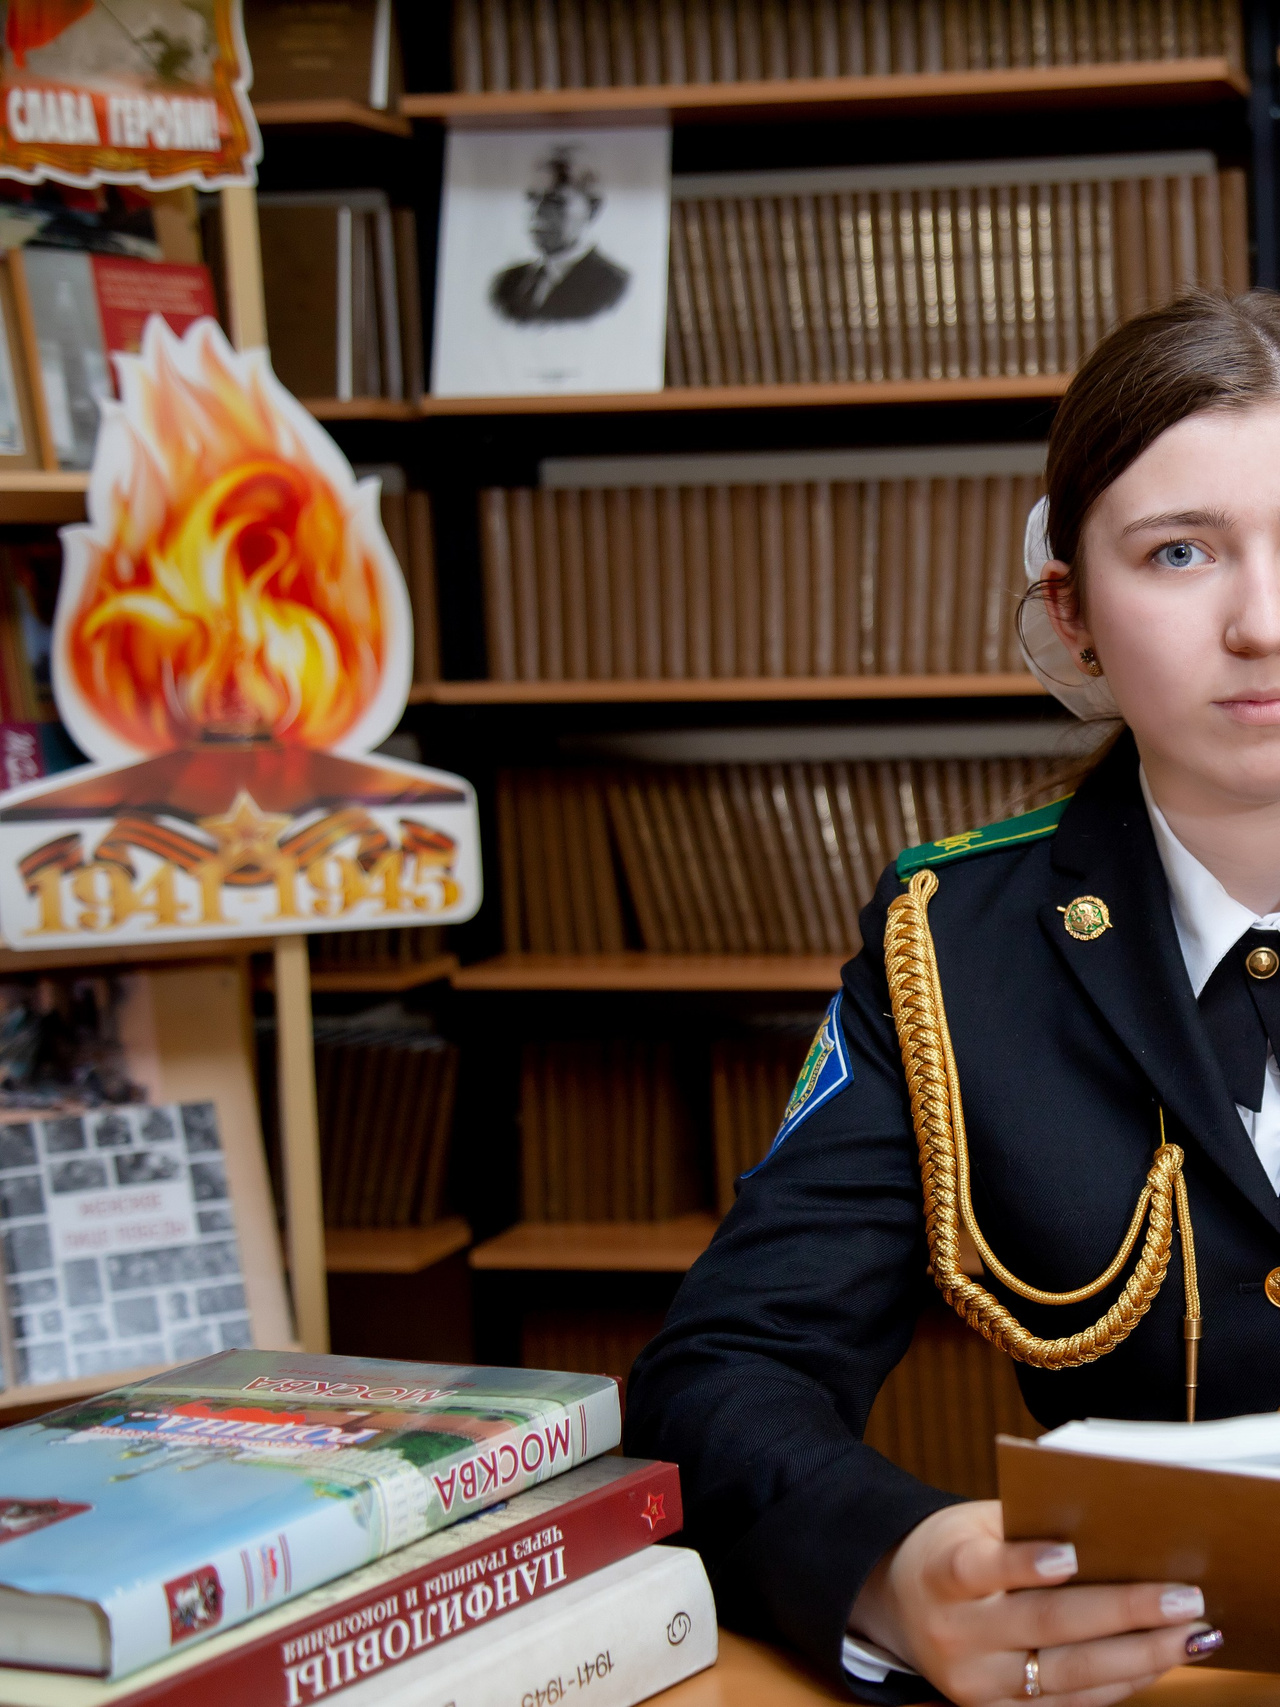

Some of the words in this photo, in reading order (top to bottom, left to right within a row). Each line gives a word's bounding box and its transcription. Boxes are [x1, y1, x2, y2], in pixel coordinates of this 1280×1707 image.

[8, 88, 100, 146] СЛАВА
[22, 850, 464, 937] 1941-1945
[241, 1376, 457, 1404] МОСКВА
[431, 1415, 572, 1515] МОСКВА
[512, 1524, 564, 1561] ЧЕРЕЗ
[404, 1584, 419, 1610] И
[424, 1546, 508, 1600] ГРАНИЦЫ
[281, 1594, 400, 1665] ПОКОЛЕНИЯ
[284, 1545, 568, 1707] ПАНФИЛОВЦЫ
